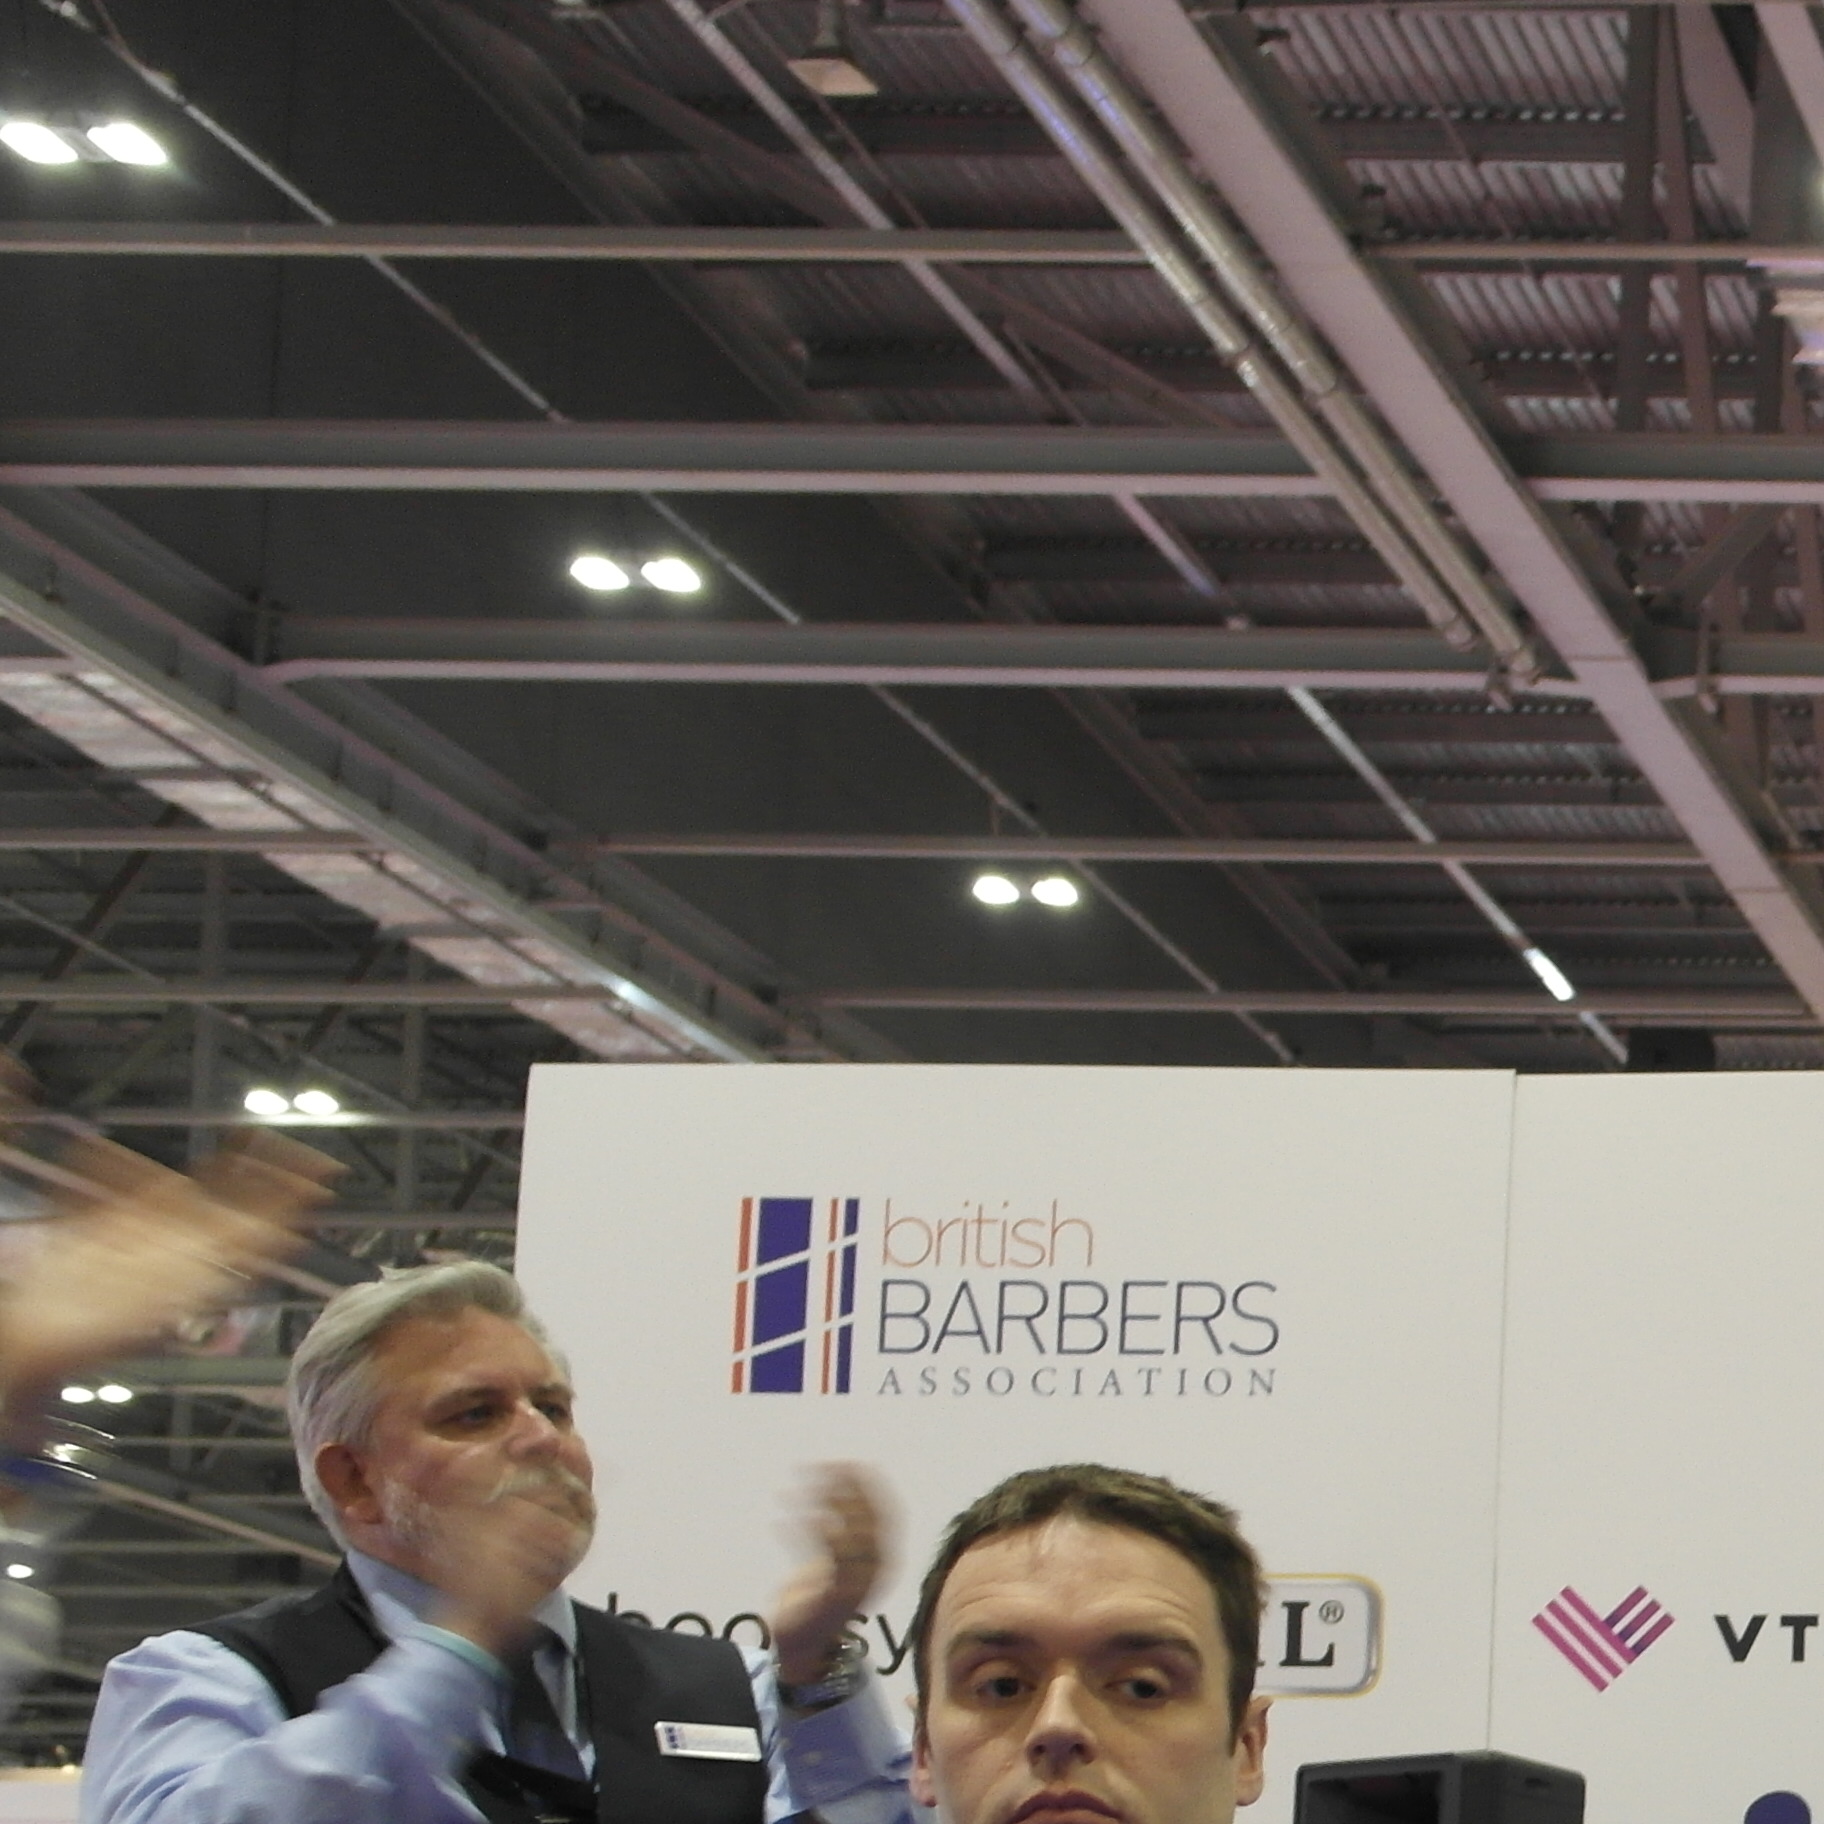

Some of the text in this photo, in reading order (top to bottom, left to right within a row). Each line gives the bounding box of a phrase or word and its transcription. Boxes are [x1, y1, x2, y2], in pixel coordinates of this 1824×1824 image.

[881, 1200, 1095, 1268] british
[879, 1280, 1280, 1355] BARBERS
[879, 1366, 1278, 1396] ASSOCIATION
